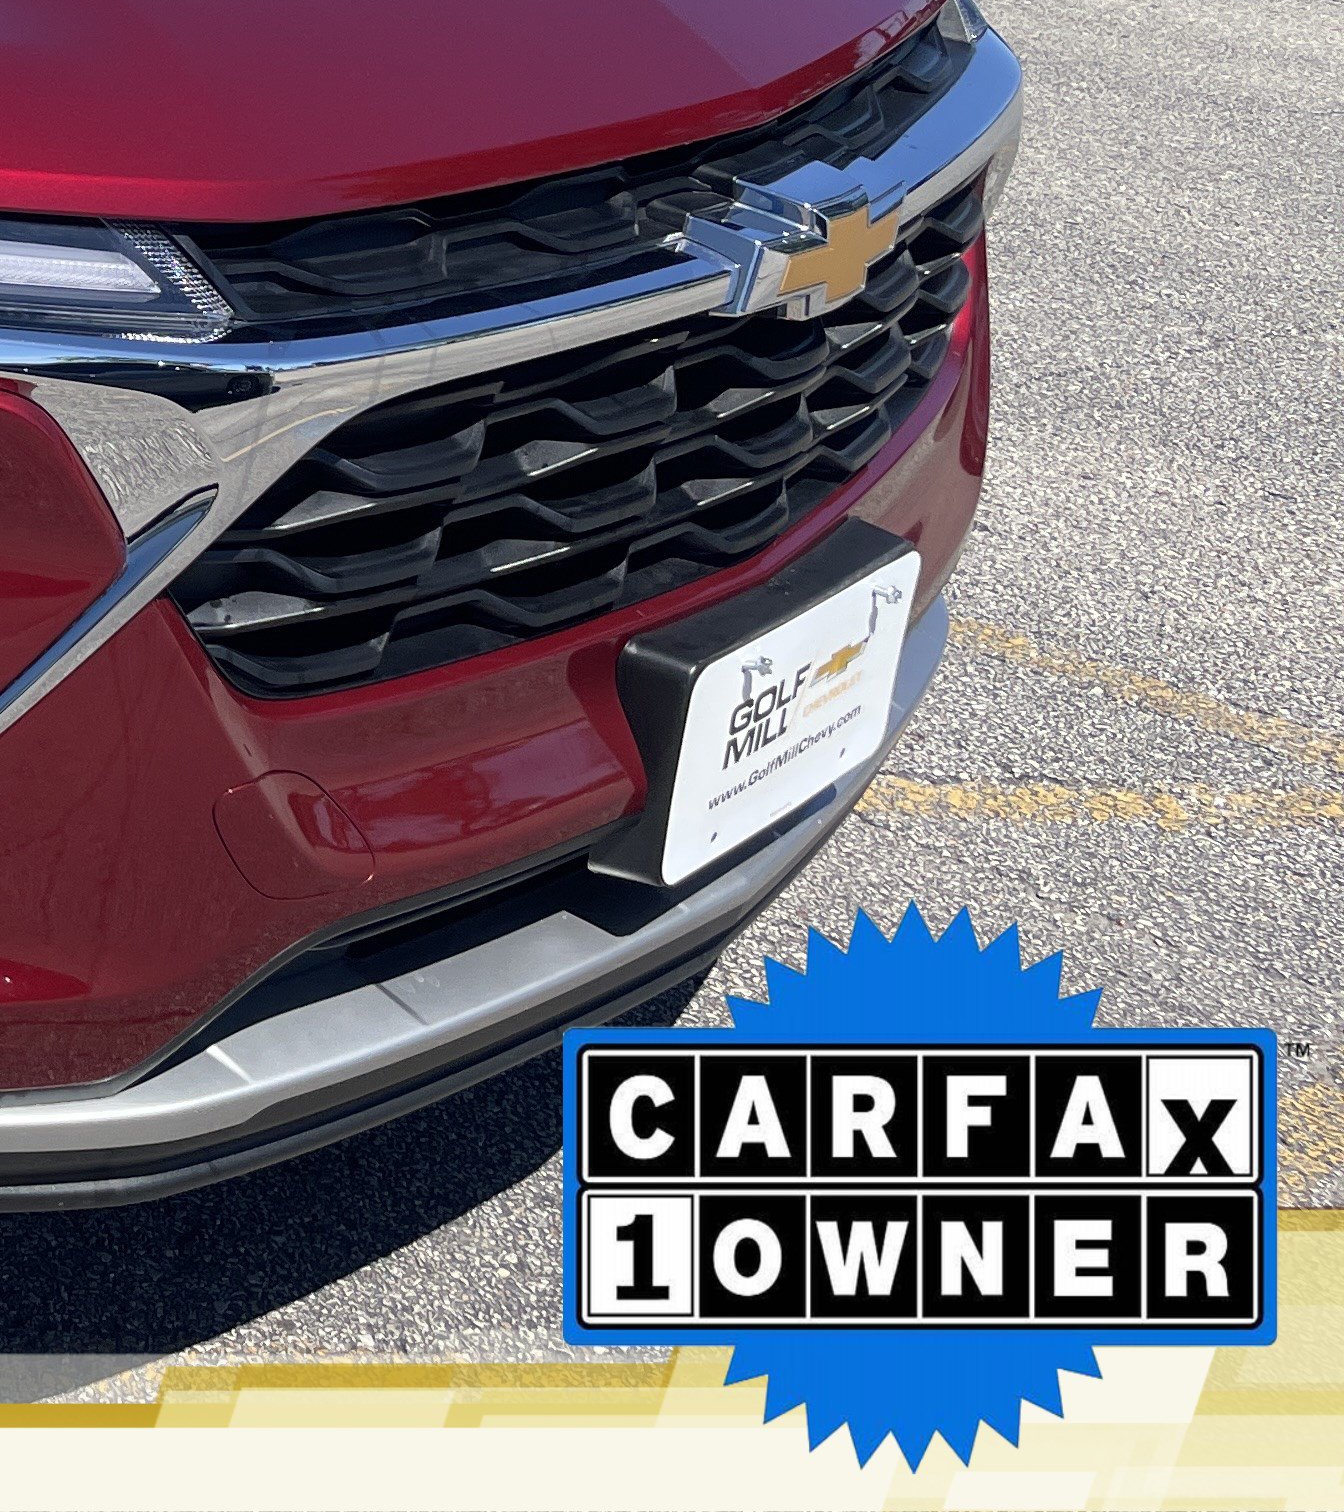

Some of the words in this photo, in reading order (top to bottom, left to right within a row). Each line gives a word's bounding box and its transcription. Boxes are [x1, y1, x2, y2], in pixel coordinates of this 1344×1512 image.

[729, 662, 812, 736] GOLF
[708, 705, 862, 810] www.GolfMillChevy.com
[722, 707, 787, 770] MILL
